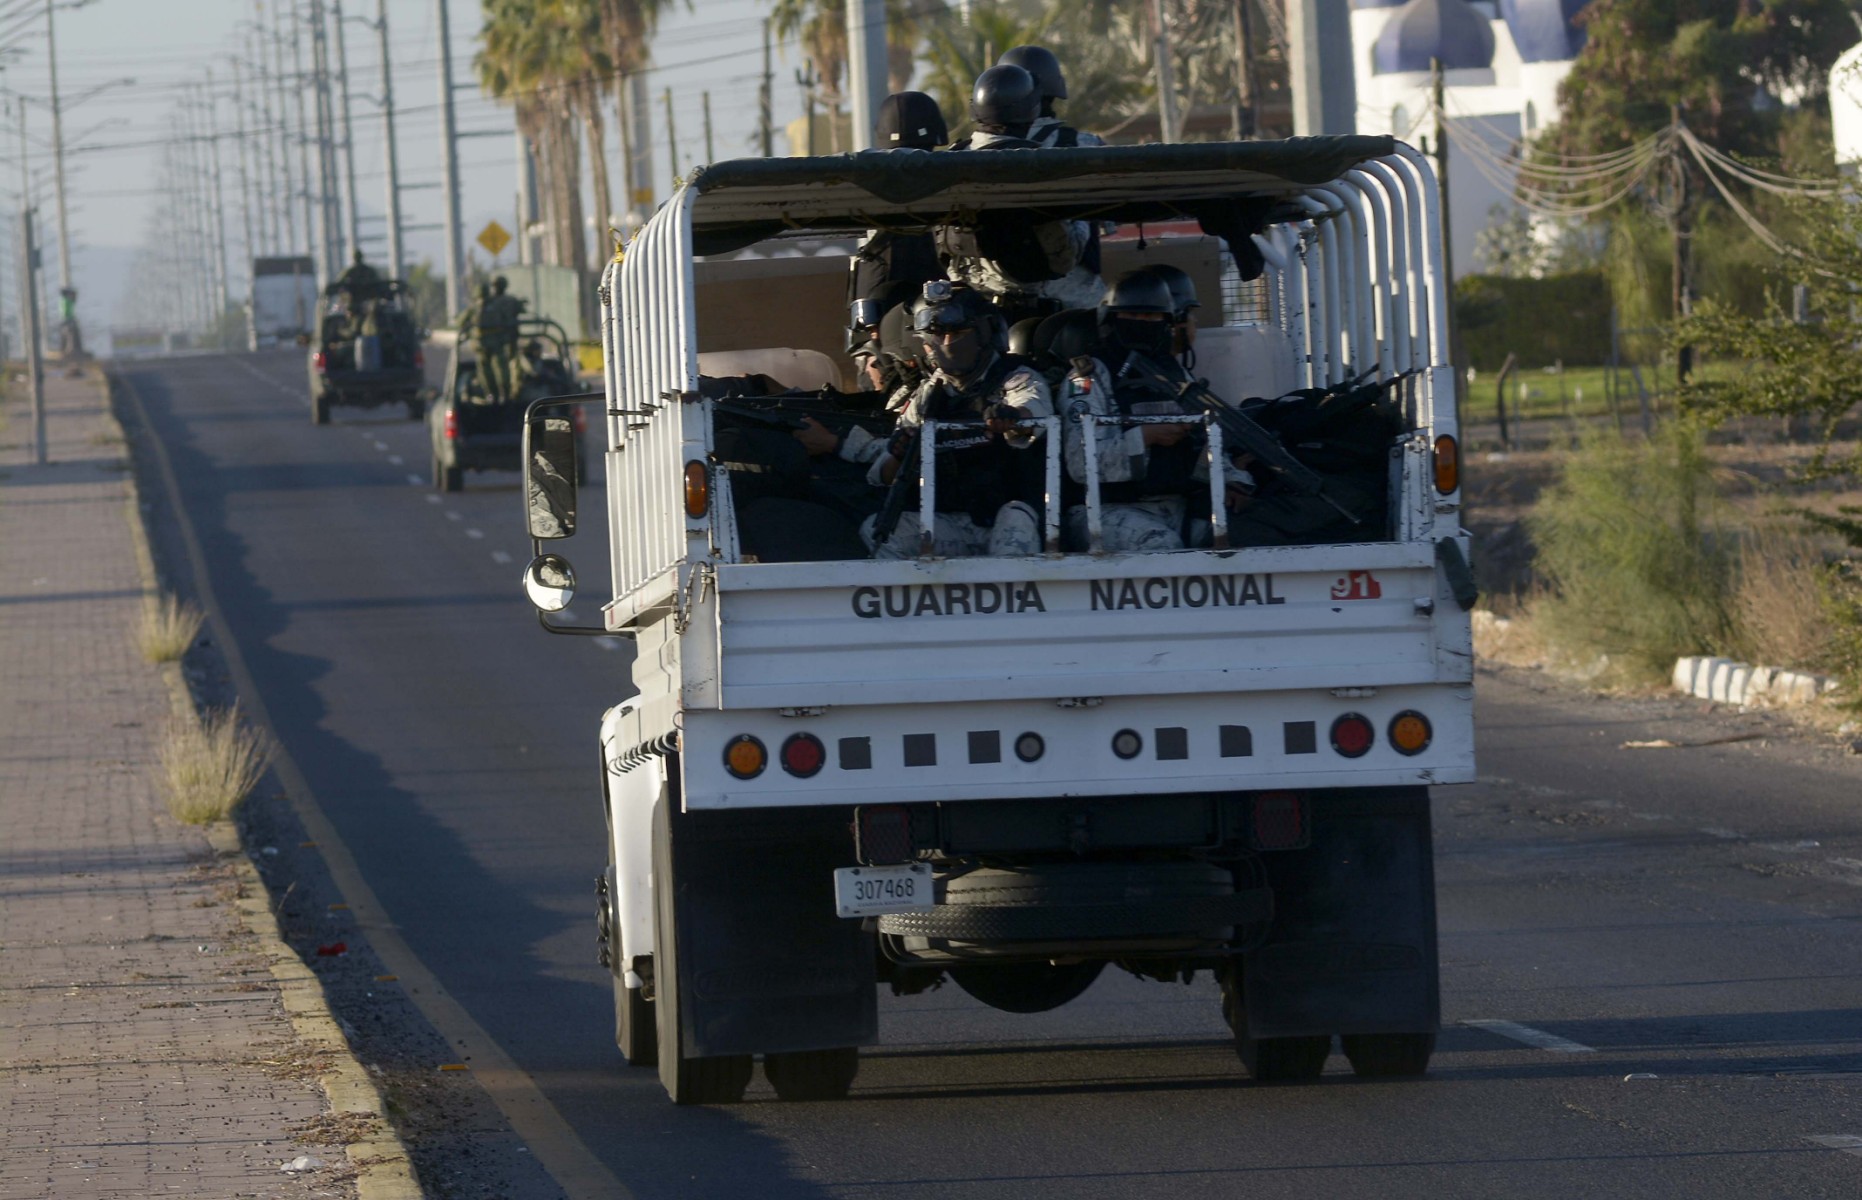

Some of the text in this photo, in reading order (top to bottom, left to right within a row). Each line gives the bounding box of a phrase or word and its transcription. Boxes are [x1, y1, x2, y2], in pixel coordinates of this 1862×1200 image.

[851, 573, 1286, 617] GUARDIA NACIONAL
[1331, 574, 1370, 598] 91
[854, 878, 915, 900] 307468
